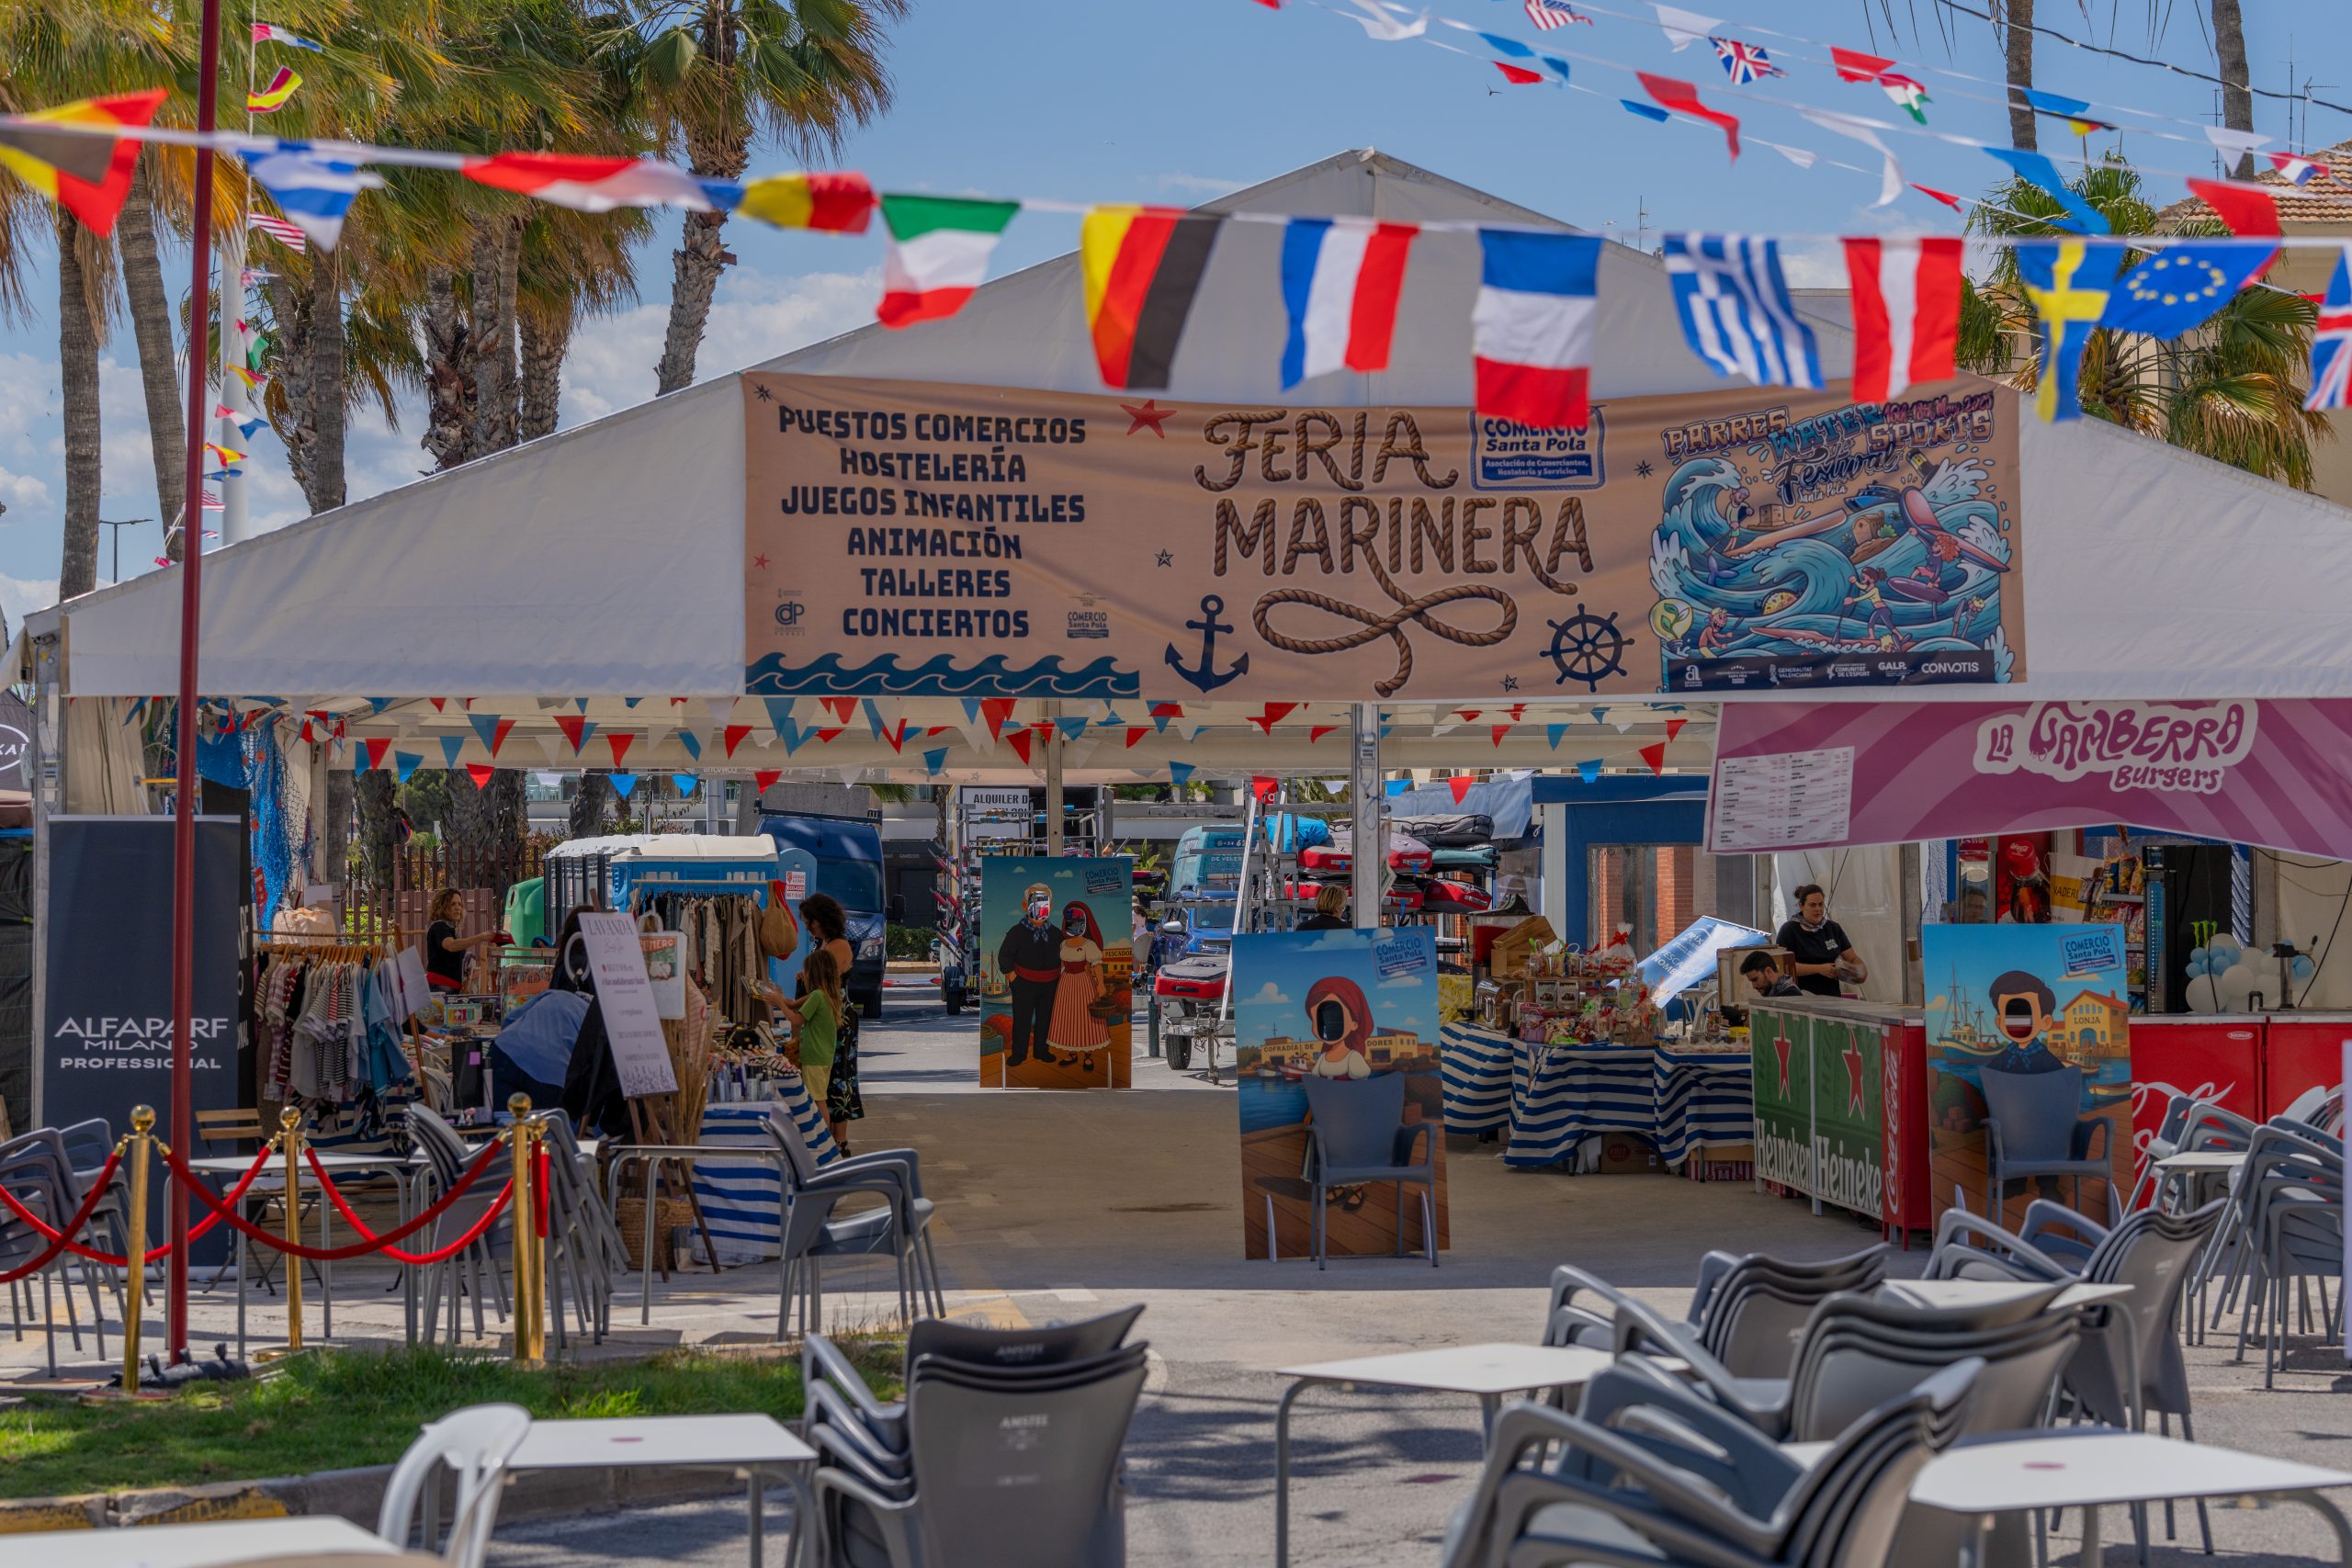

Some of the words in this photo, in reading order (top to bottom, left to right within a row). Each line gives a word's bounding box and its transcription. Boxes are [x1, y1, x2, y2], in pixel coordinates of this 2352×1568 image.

[779, 405, 907, 440] PUESTOS
[915, 413, 1086, 444] COMERCIOS
[1665, 407, 1789, 457] PARRES
[1768, 402, 1885, 461] WATER
[1868, 411, 1993, 453] SPORTS
[1194, 408, 1459, 491] FERIA
[1486, 438, 1540, 452] Santa
[1546, 436, 1586, 452] Pola
[840, 446, 1026, 482] HOSTELERÍA
[1798, 485, 1824, 503] Santa
[781, 487, 897, 515] JUEGOS
[904, 489, 1085, 523] INFANTILES
[847, 525, 1023, 559] ANIMACIÓN
[1214, 496, 1595, 597] MARINERA
[861, 568, 1011, 598] TALLERES
[842, 608, 1030, 638] CONCIERTOS
[1068, 611, 1108, 622] COMERCIO
[1921, 662, 1979, 674] CONVOTIS
[2114, 765, 2221, 788] Burgers
[974, 794, 1019, 805] ALQUILER
[1085, 866, 1119, 879] COMERCIO
[1376, 937, 1421, 955] COMERCIO
[2065, 935, 2110, 953] COMERCIO
[1379, 953, 1403, 964] Santa
[2068, 951, 2092, 960] Santa
[2074, 1016, 2101, 1025] LONJA
[1263, 1043, 1298, 1053] COFRADÍA
[61, 1057, 221, 1069] PROFESSIOAL
